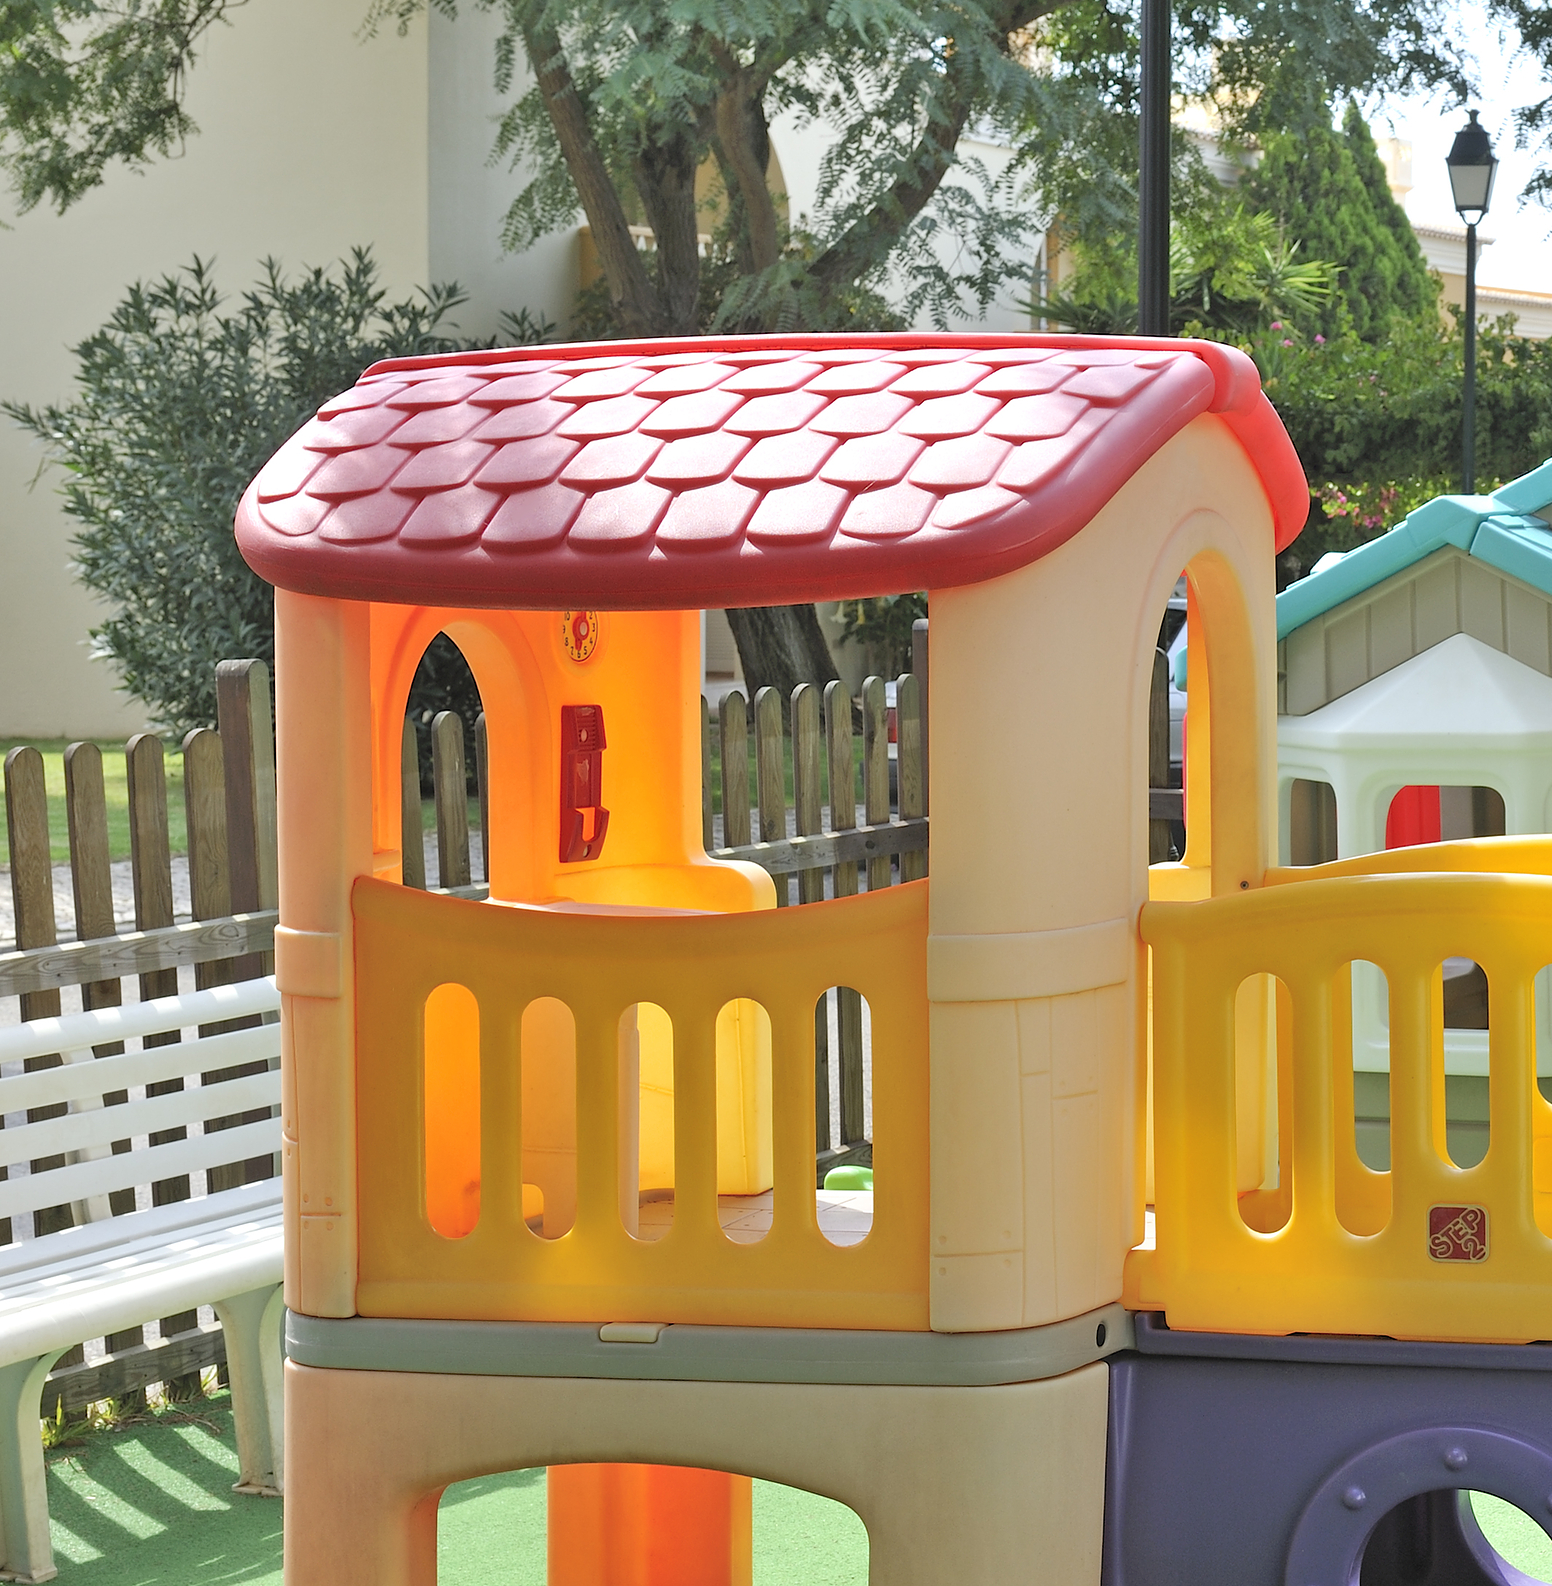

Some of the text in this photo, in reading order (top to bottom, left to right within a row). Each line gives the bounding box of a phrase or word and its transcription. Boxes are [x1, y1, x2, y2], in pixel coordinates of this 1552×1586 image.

[592, 623, 596, 633] 3
[564, 637, 569, 647] 8
[570, 646, 574, 655] 7
[577, 650, 581, 658] 6
[583, 646, 588, 655] 5
[1430, 1207, 1481, 1257] STEP
[1462, 1236, 1486, 1260] 2
